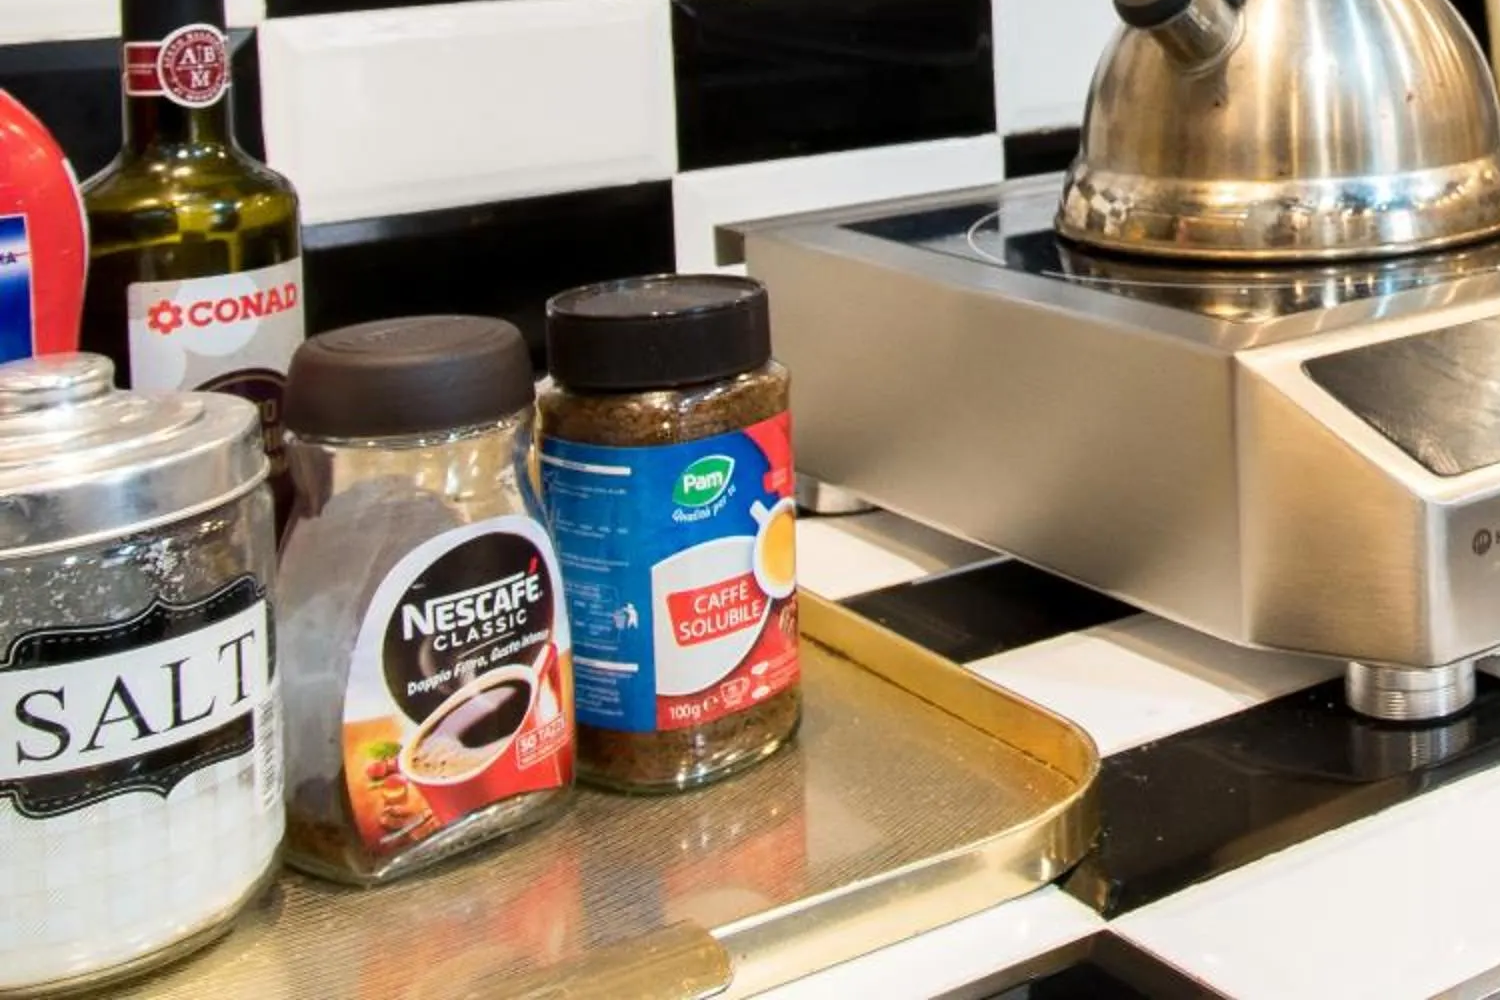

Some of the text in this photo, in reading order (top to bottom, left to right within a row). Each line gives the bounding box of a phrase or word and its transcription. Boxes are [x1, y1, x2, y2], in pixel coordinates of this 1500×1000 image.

[190, 70, 211, 89] M
[187, 281, 298, 328] CONAD
[683, 470, 723, 495] Pam
[433, 609, 528, 651] CLASSIC
[678, 599, 763, 641] SOLUBILE
[15, 629, 255, 766] SALT
[407, 668, 451, 697] Doppio
[669, 703, 702, 721] 100g
